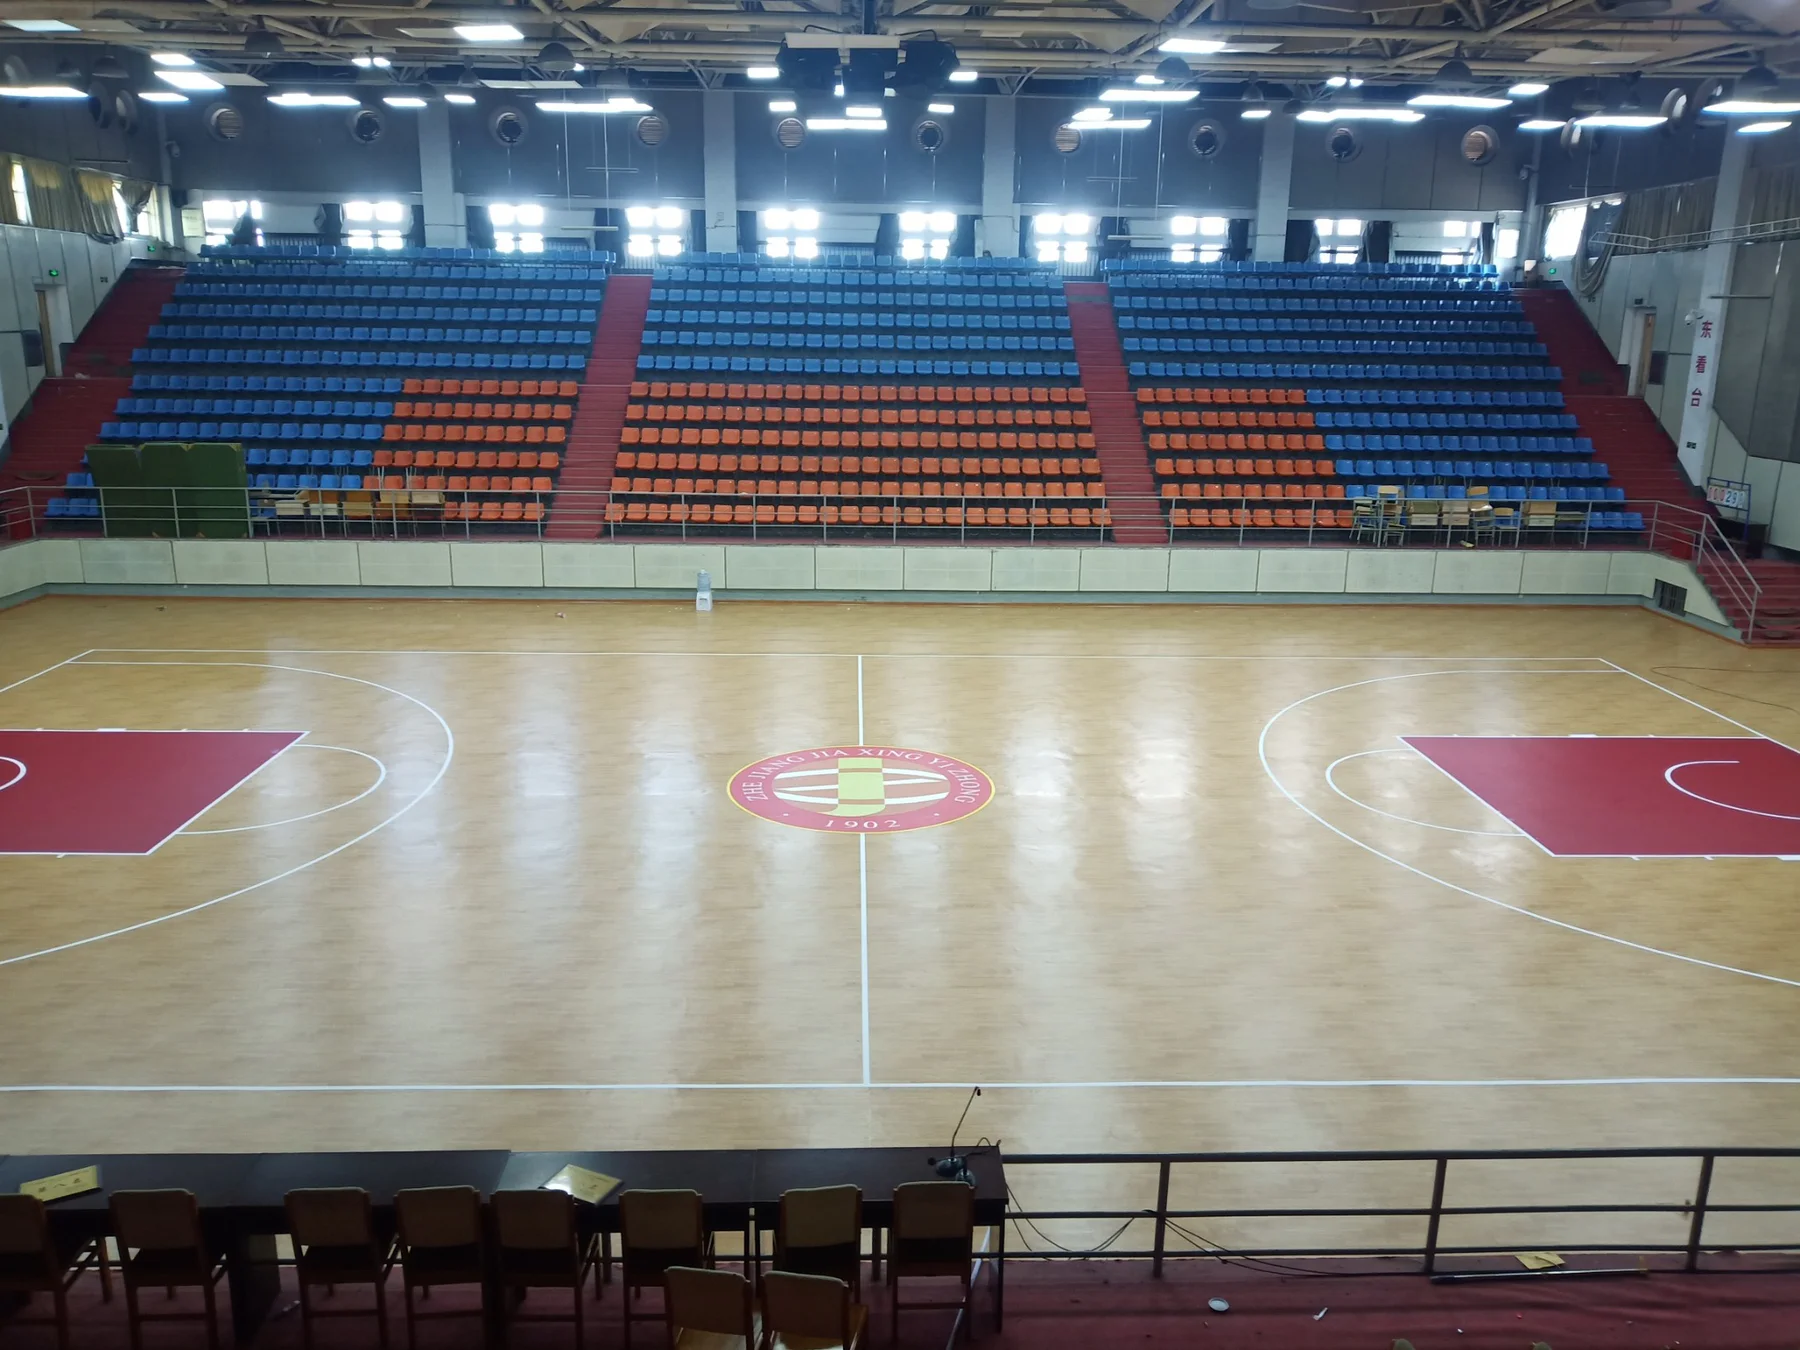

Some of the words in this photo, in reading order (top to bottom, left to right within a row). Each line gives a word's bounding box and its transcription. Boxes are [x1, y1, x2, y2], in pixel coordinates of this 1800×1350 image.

[1691, 320, 1713, 407] 东看台
[810, 749, 849, 759] JIA
[857, 748, 923, 760] XING
[748, 755, 805, 779] JIANG
[928, 757, 954, 769] YI
[741, 781, 769, 802] ZHE
[948, 768, 981, 804] ZHONG
[825, 819, 901, 829] 1902
